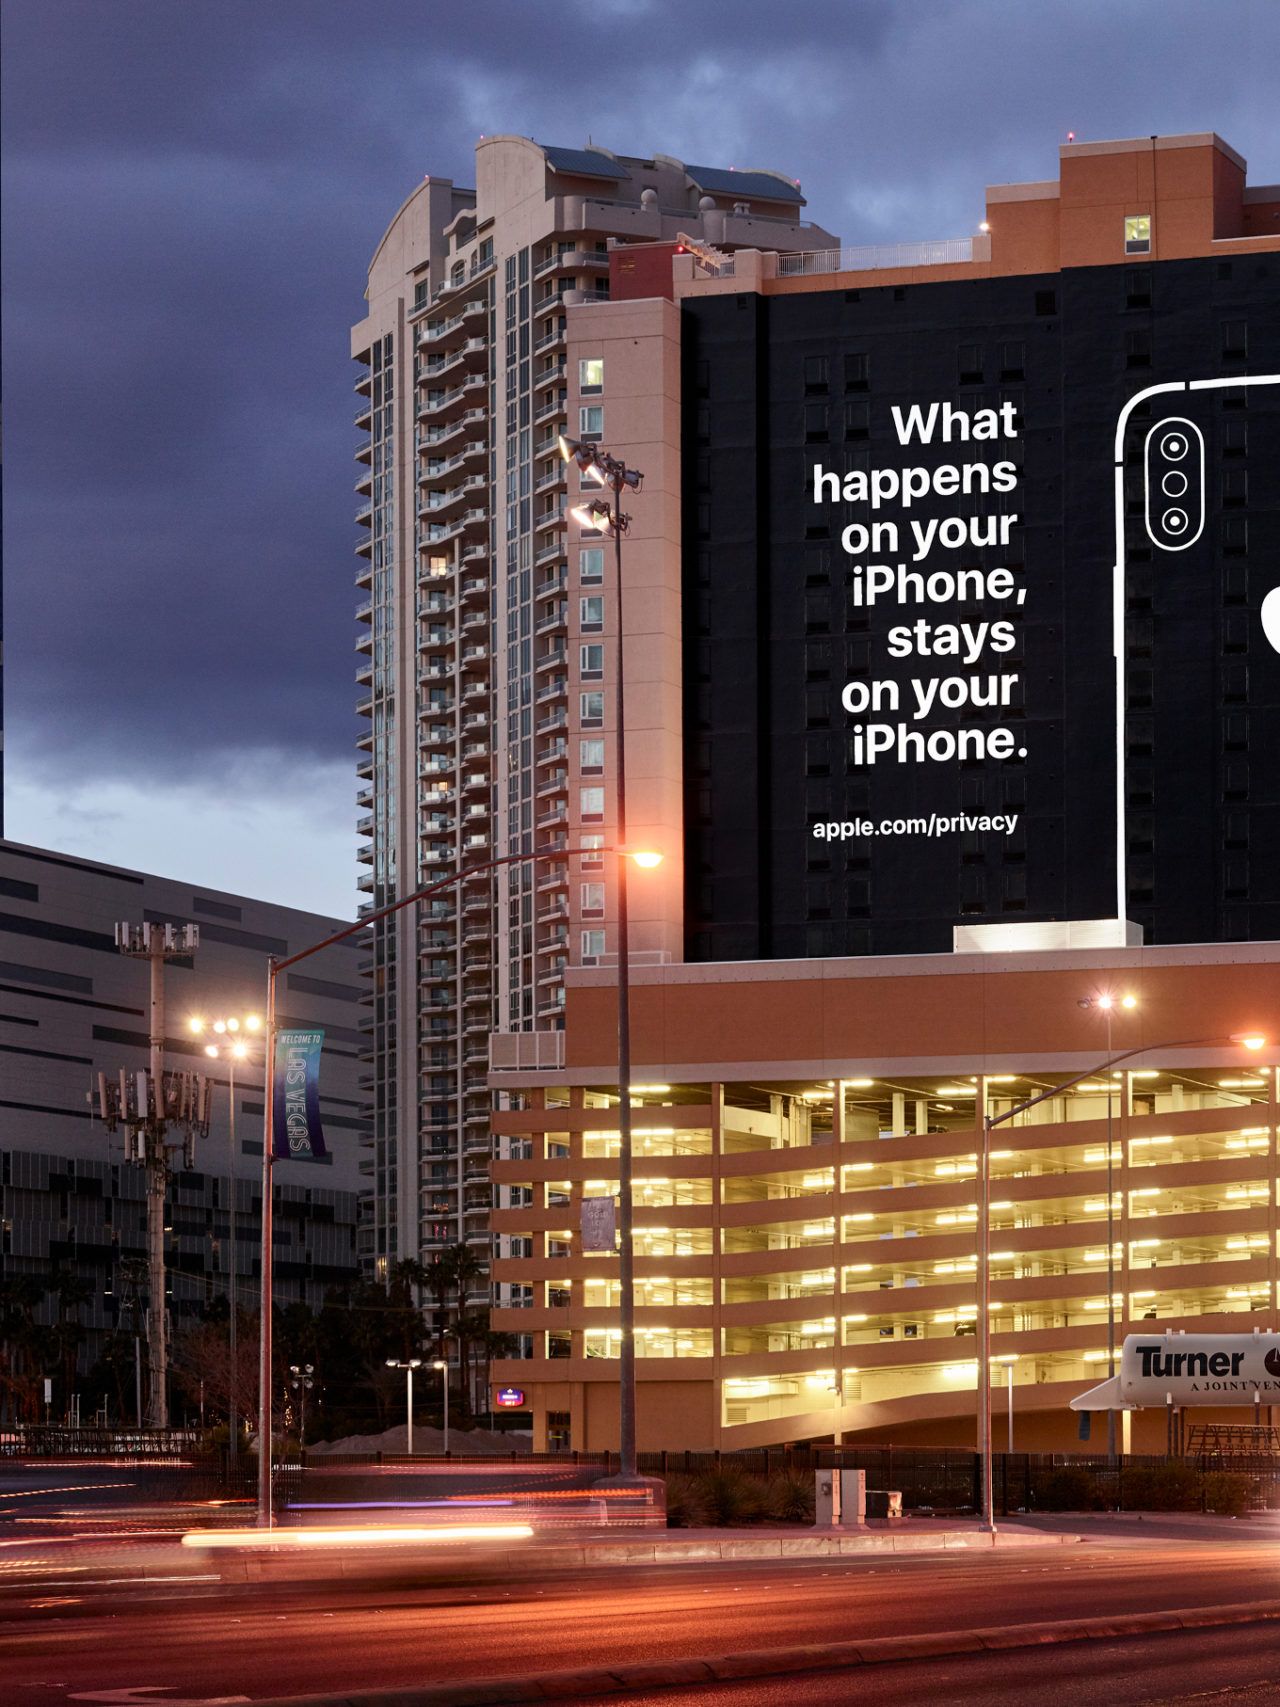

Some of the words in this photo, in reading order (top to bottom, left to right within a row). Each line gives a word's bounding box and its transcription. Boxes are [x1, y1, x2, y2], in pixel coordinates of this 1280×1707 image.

[890, 401, 1018, 446] What
[813, 460, 1018, 510] happens
[841, 521, 899, 555] on
[910, 513, 1018, 562] your
[853, 563, 1027, 607] iPhone,
[887, 618, 1016, 665] stays
[841, 679, 900, 714] on
[910, 673, 1019, 720] your
[853, 722, 1028, 766] iPhone.
[812, 811, 1019, 842] apple.com/privacy
[281, 1035, 311, 1043] WELCOME
[312, 1034, 321, 1043] TO
[286, 1047, 308, 1085] LAS
[286, 1088, 310, 1152] VEGAS
[1136, 1345, 1245, 1378] Turner
[1191, 1382, 1200, 1392] A
[1204, 1381, 1248, 1391] JOINT
